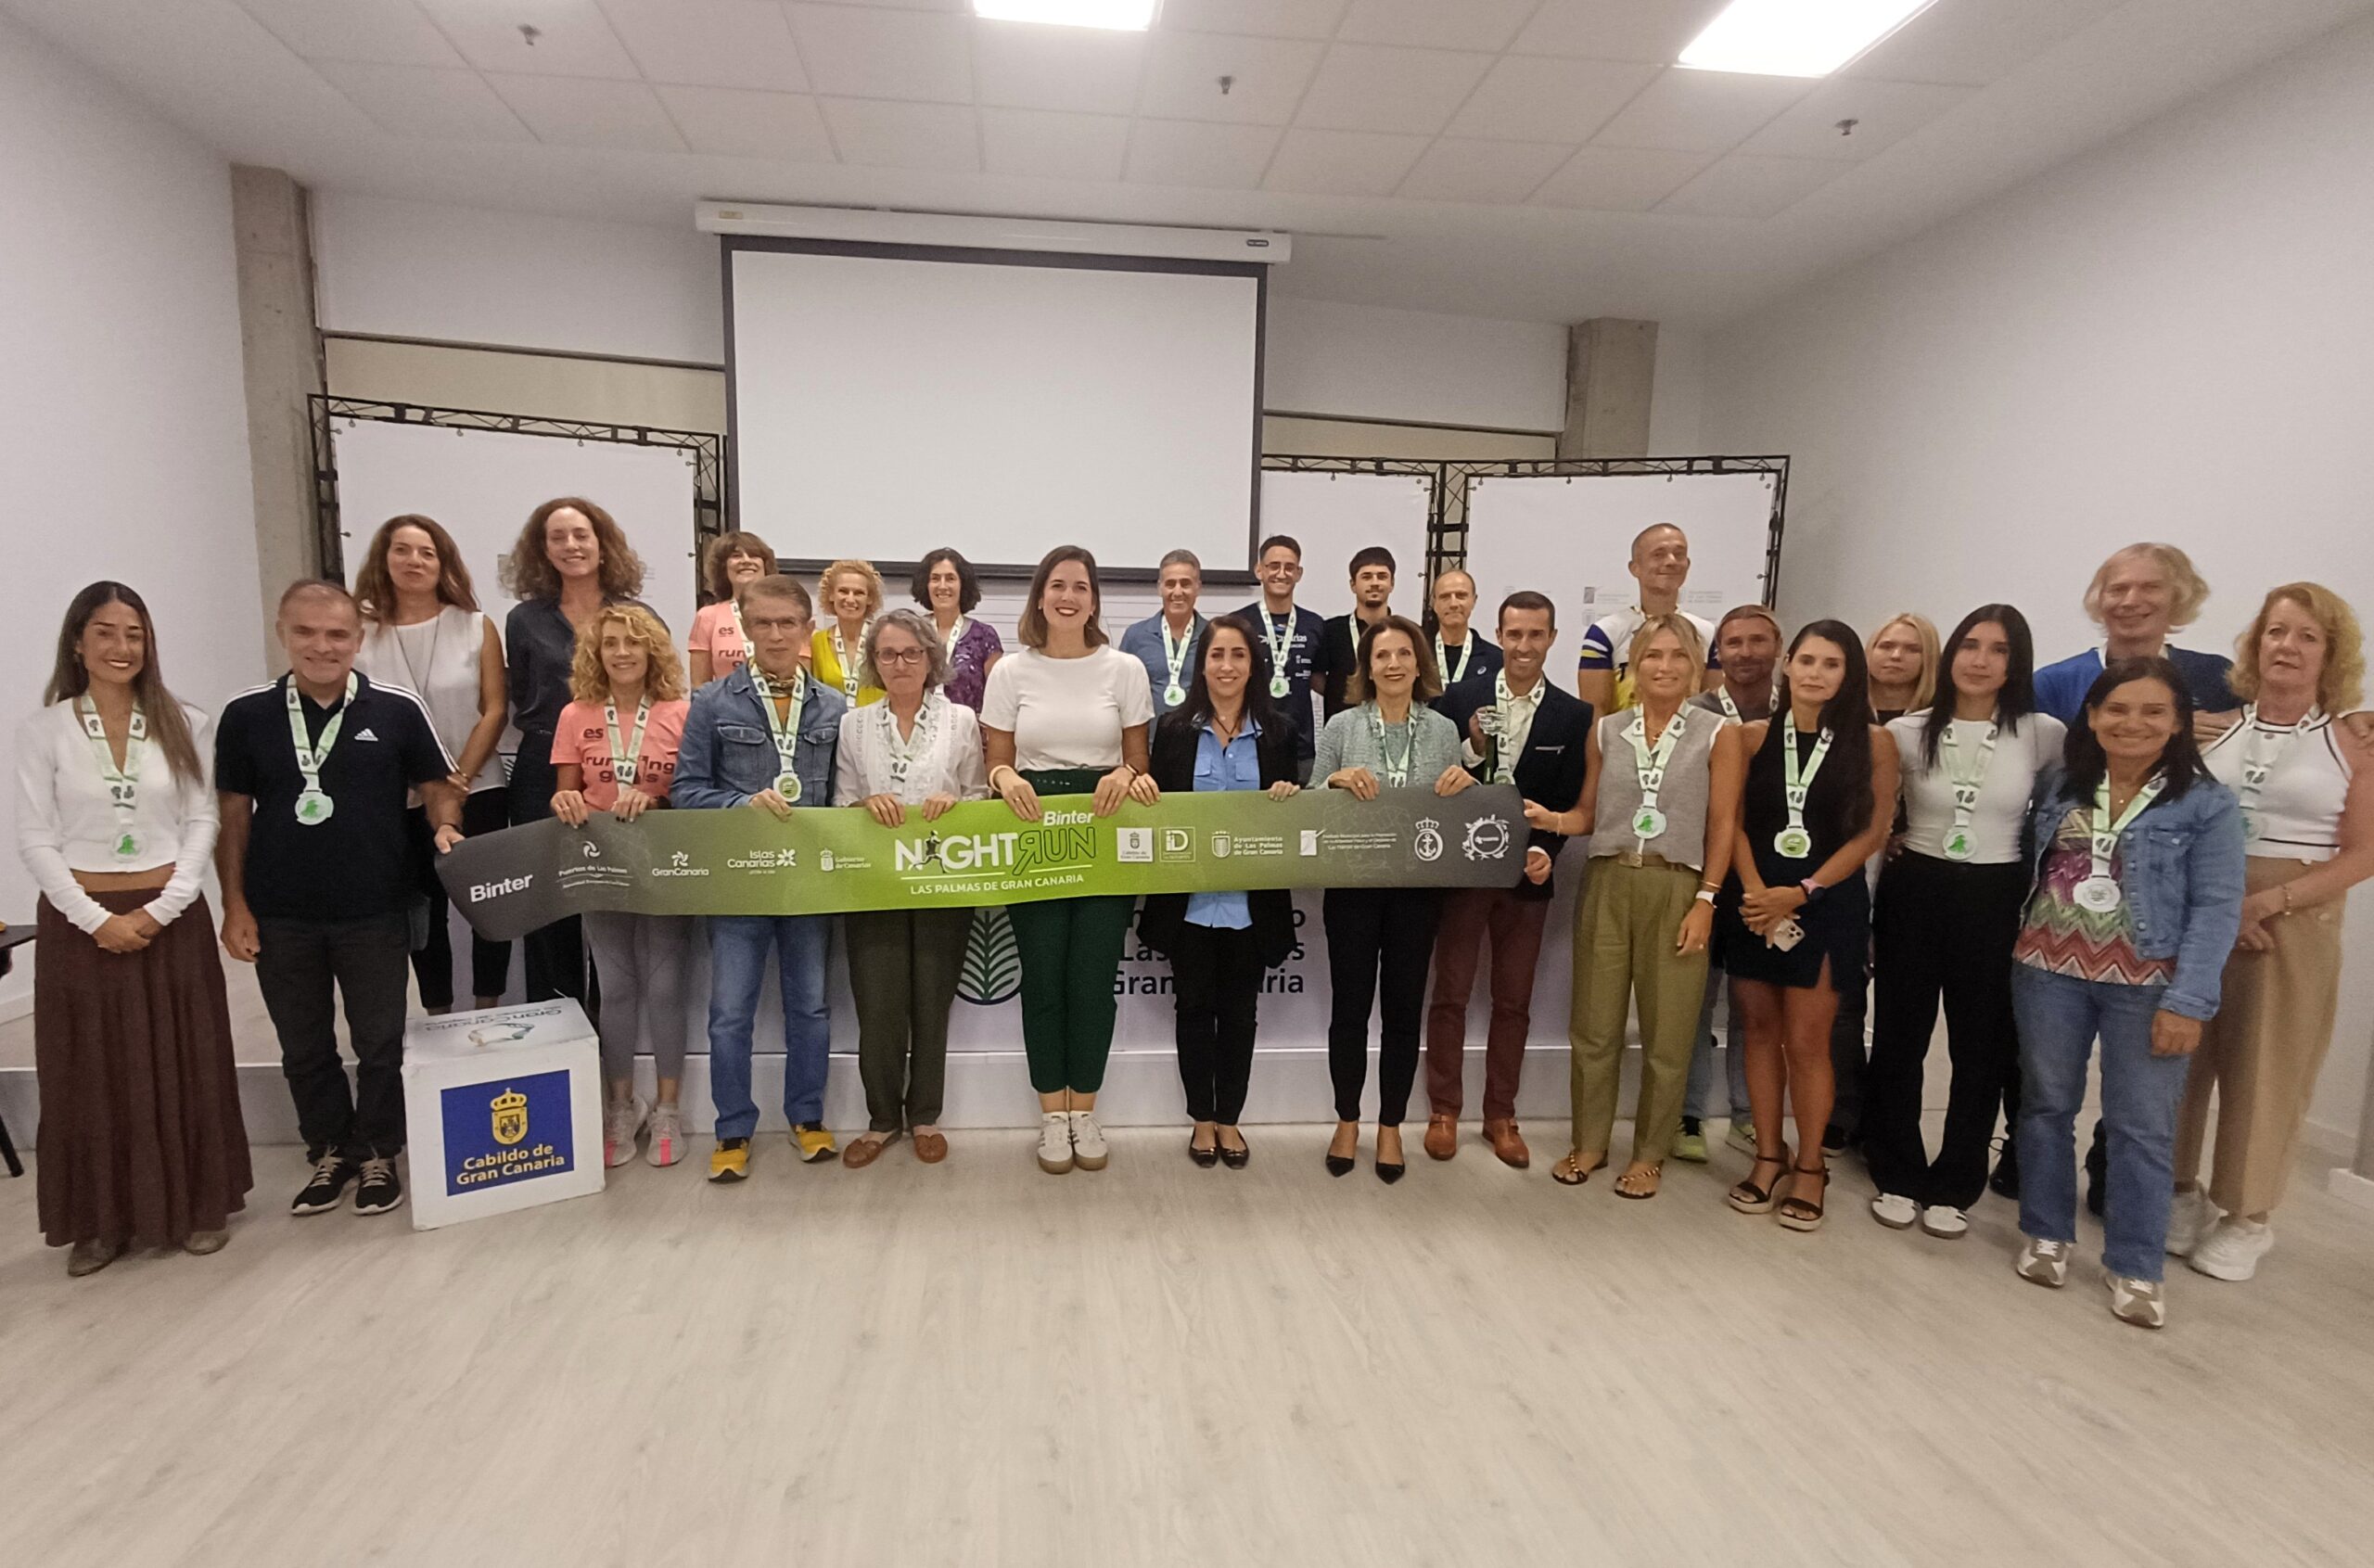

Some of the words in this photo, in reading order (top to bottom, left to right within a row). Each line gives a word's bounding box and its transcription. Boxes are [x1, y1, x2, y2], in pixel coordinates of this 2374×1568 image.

[719, 627, 734, 635] es
[583, 728, 604, 739] es
[1043, 810, 1094, 826] Binter
[749, 850, 774, 860] Islas
[727, 858, 775, 868] Canarias
[652, 868, 709, 877] GranCanaria
[470, 874, 533, 902] Binter
[911, 885, 932, 895] LAS
[935, 882, 980, 893] PALMAS
[983, 881, 998, 890] DE
[1001, 878, 1032, 889] GRAN
[1034, 873, 1084, 886] CANARIA
[464, 1148, 529, 1170] Cabildo
[532, 1143, 554, 1156] de
[456, 1169, 498, 1185] Gran
[502, 1154, 566, 1176] Canaria
